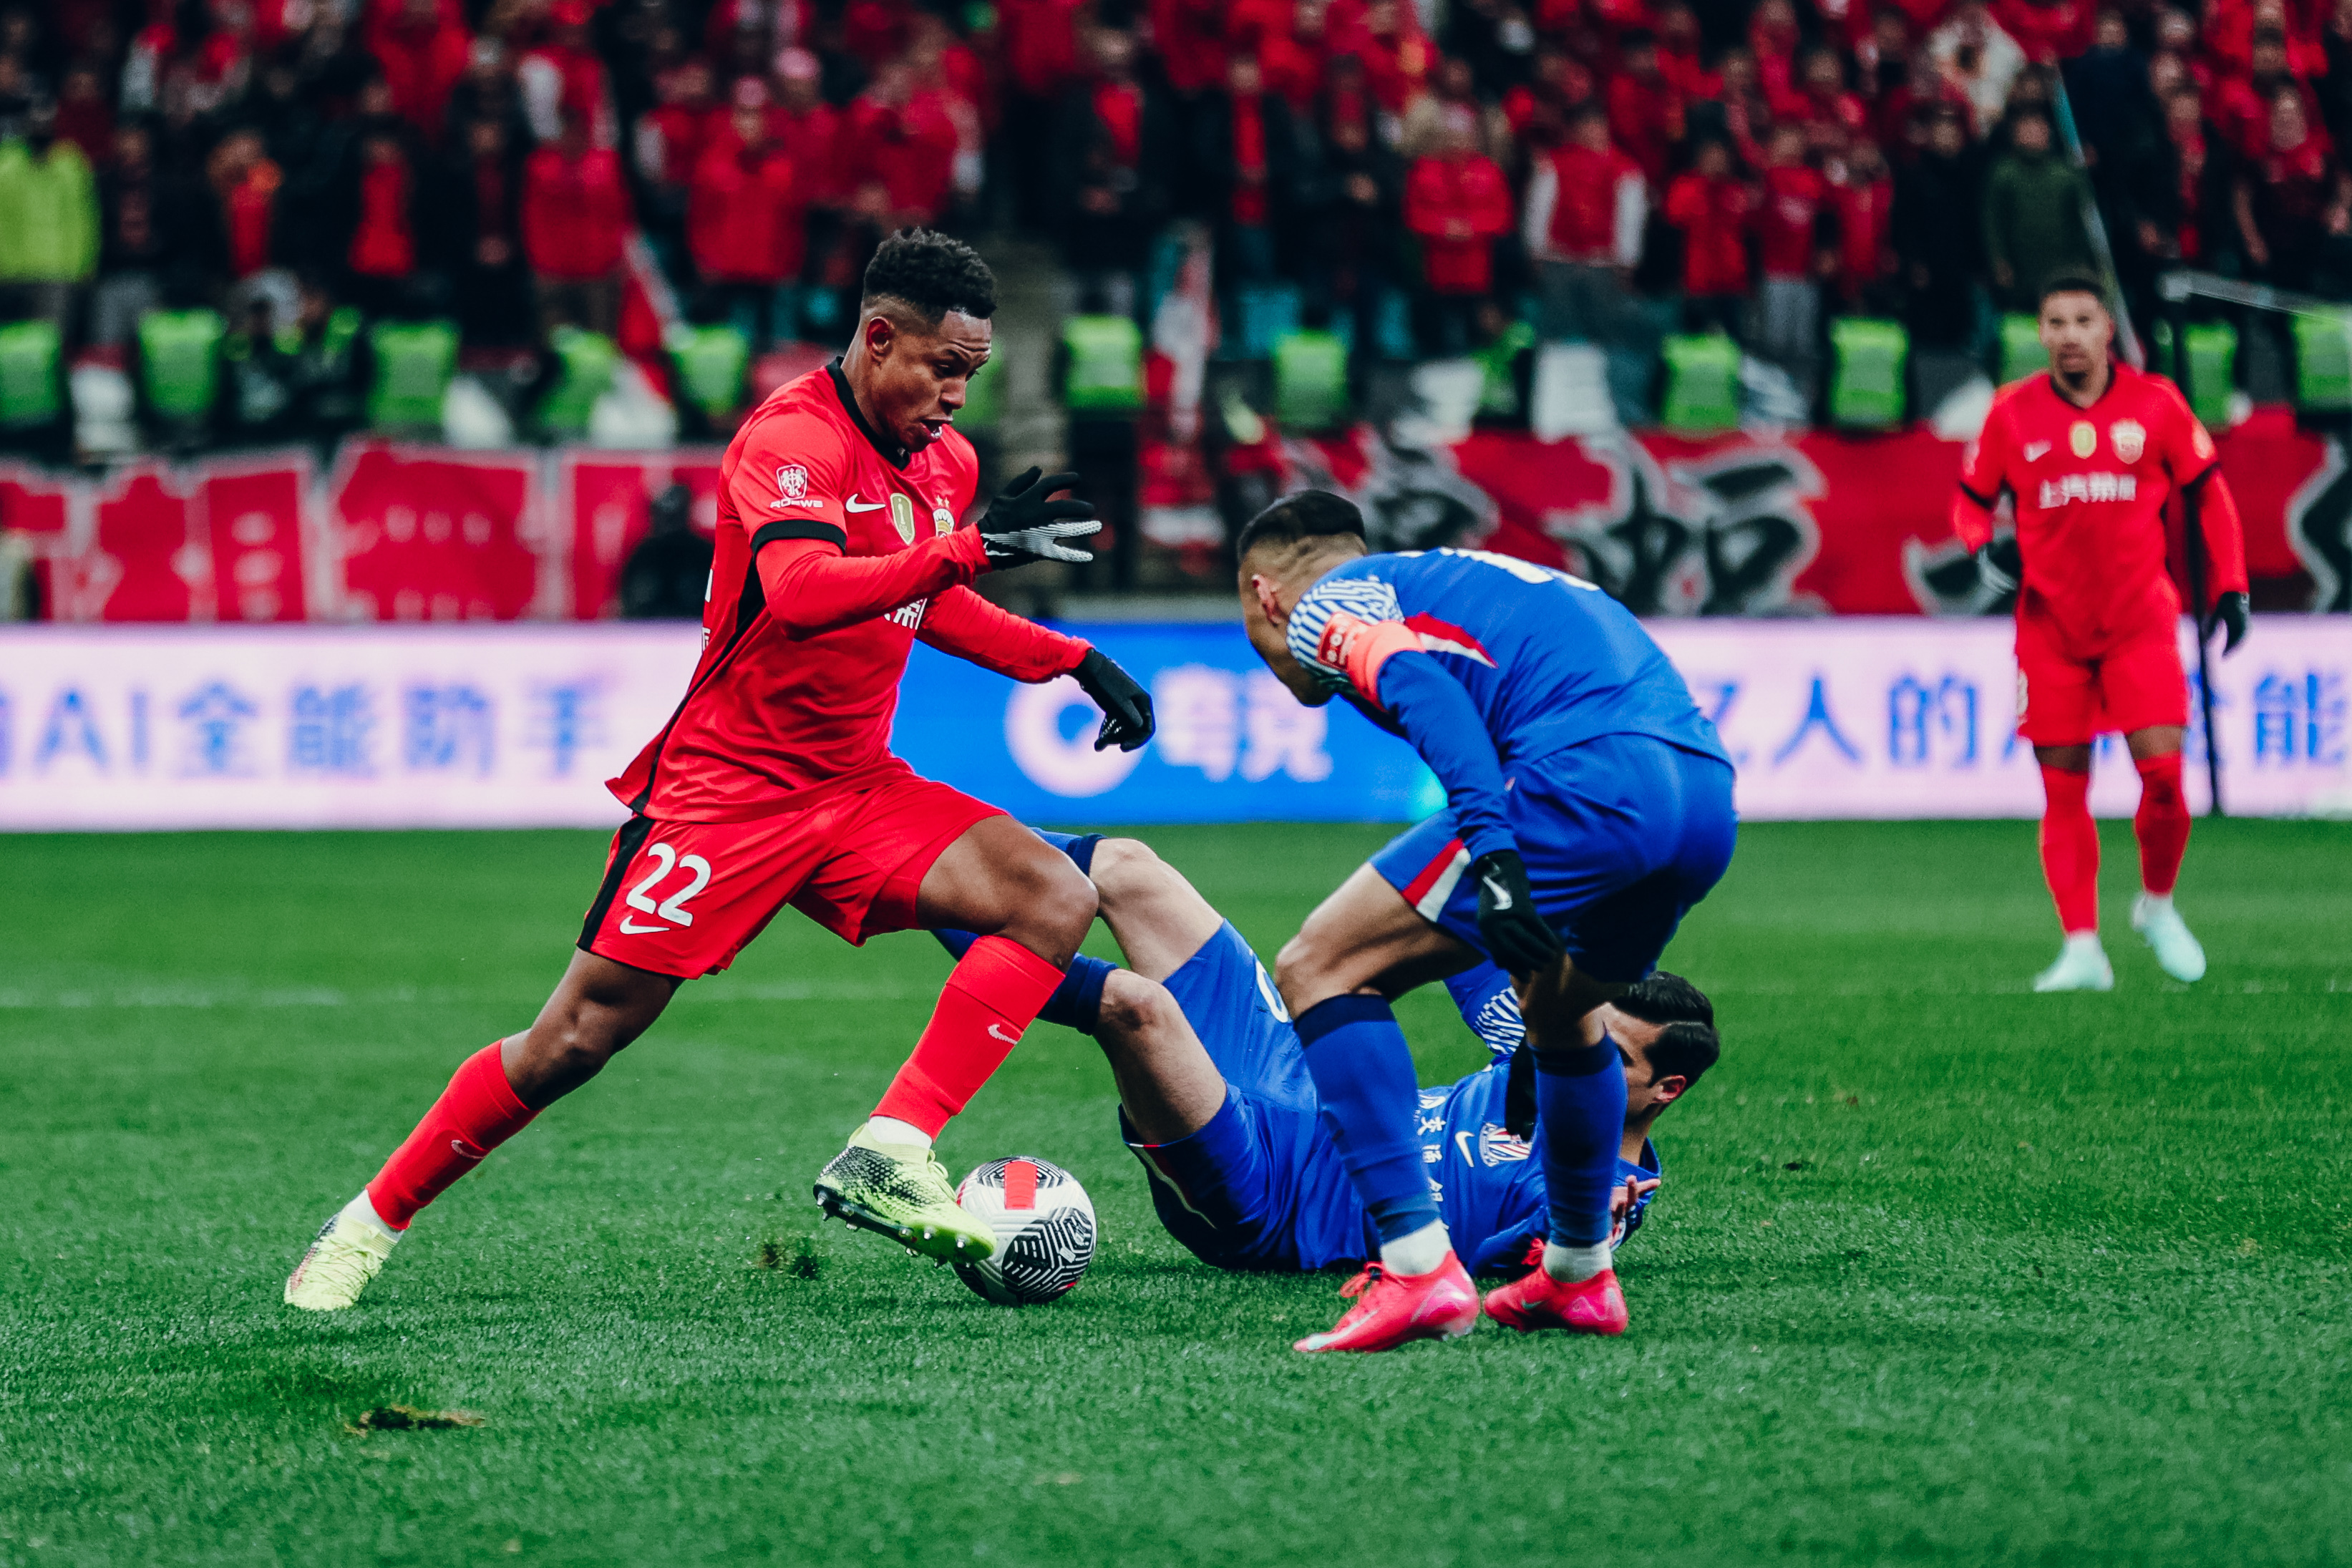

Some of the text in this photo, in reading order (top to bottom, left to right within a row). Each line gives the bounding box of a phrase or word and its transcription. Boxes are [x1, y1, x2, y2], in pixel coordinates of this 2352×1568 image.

[770, 499, 823, 508] ROEWE
[0, 682, 608, 777] AI全能助手
[626, 842, 711, 927] 22
